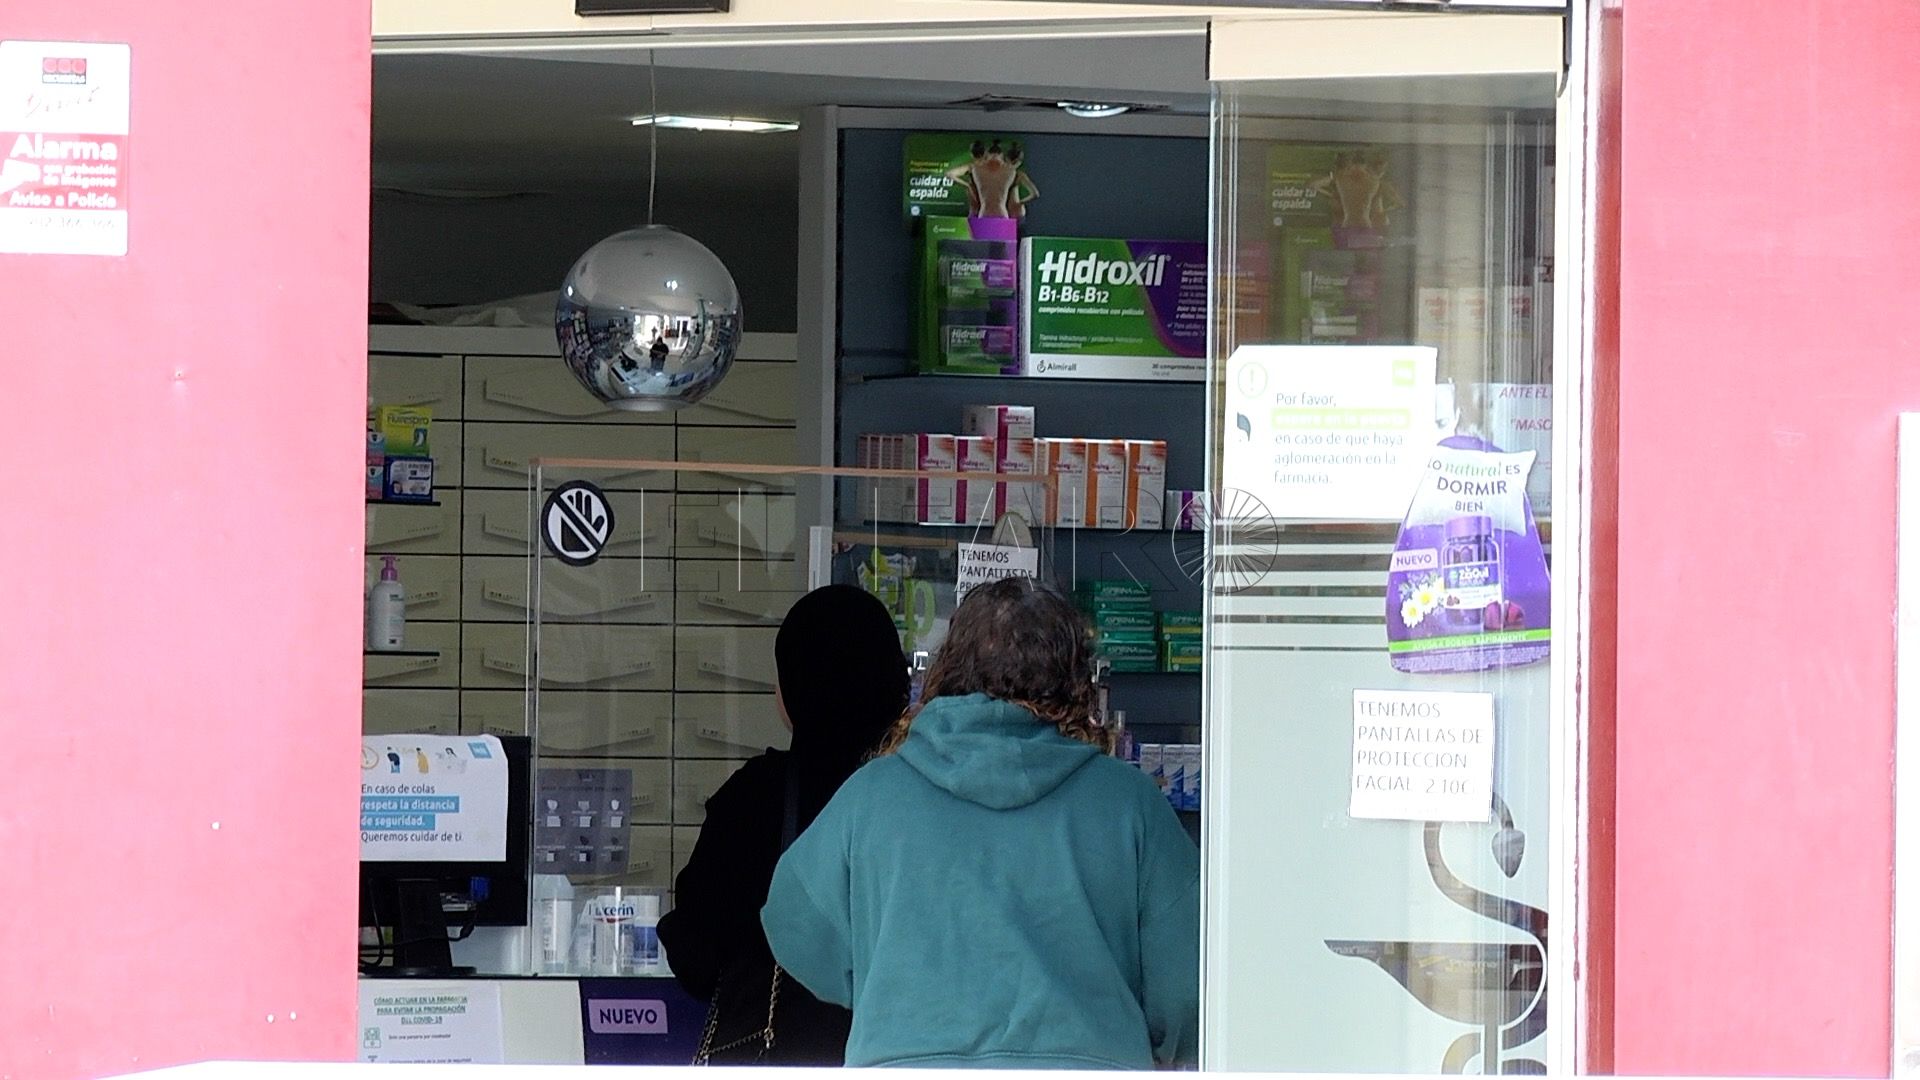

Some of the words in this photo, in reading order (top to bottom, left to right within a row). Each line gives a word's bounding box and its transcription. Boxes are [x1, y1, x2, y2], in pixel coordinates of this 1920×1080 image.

[9, 133, 118, 160] Alarma
[910, 175, 941, 186] cuidar
[942, 176, 954, 186] tu
[909, 187, 949, 200] espalda
[1272, 187, 1303, 197] cuidar
[9, 190, 51, 207] Aviso
[55, 196, 64, 207] a
[68, 191, 117, 209] Policía
[1272, 198, 1311, 210] espalda
[952, 262, 987, 273] Hidroxil
[1038, 285, 1109, 303] B1-B6-B12
[1047, 363, 1077, 372] Almirall
[1276, 392, 1297, 405] Por
[1301, 392, 1337, 407] favor,
[1500, 387, 1534, 399] ANTE
[1275, 434, 1291, 445] en
[1294, 434, 1323, 445] caso
[1326, 431, 1341, 445] de
[1345, 434, 1369, 447] que
[1373, 431, 1403, 447] haya
[1274, 451, 1362, 467] aglomeración
[1365, 453, 1381, 465] en
[1385, 451, 1396, 465] la
[1445, 461, 1501, 477] natural
[1506, 464, 1520, 475] ES
[1437, 476, 1508, 496] DORMIR
[1455, 500, 1484, 512] BIEN
[961, 549, 1009, 563] TENEMOS
[1396, 554, 1432, 566] NUEVO
[1358, 701, 1441, 718] TENEMOS
[1358, 725, 1456, 744] PANTALLAS
[1462, 728, 1484, 744] DE
[1357, 750, 1467, 768] PROTECCION
[361, 784, 373, 794] En
[375, 785, 396, 794] caso
[397, 784, 409, 794] de
[411, 784, 436, 794] colas
[1356, 774, 1412, 791] FACIAL
[361, 799, 398, 812] respeta
[400, 799, 410, 810] la
[411, 799, 456, 810] distancia
[361, 815, 373, 826] de
[361, 831, 409, 843] Queremos
[410, 831, 439, 842] cuidar
[441, 831, 453, 842] de
[600, 1008, 658, 1024] NUEVO
